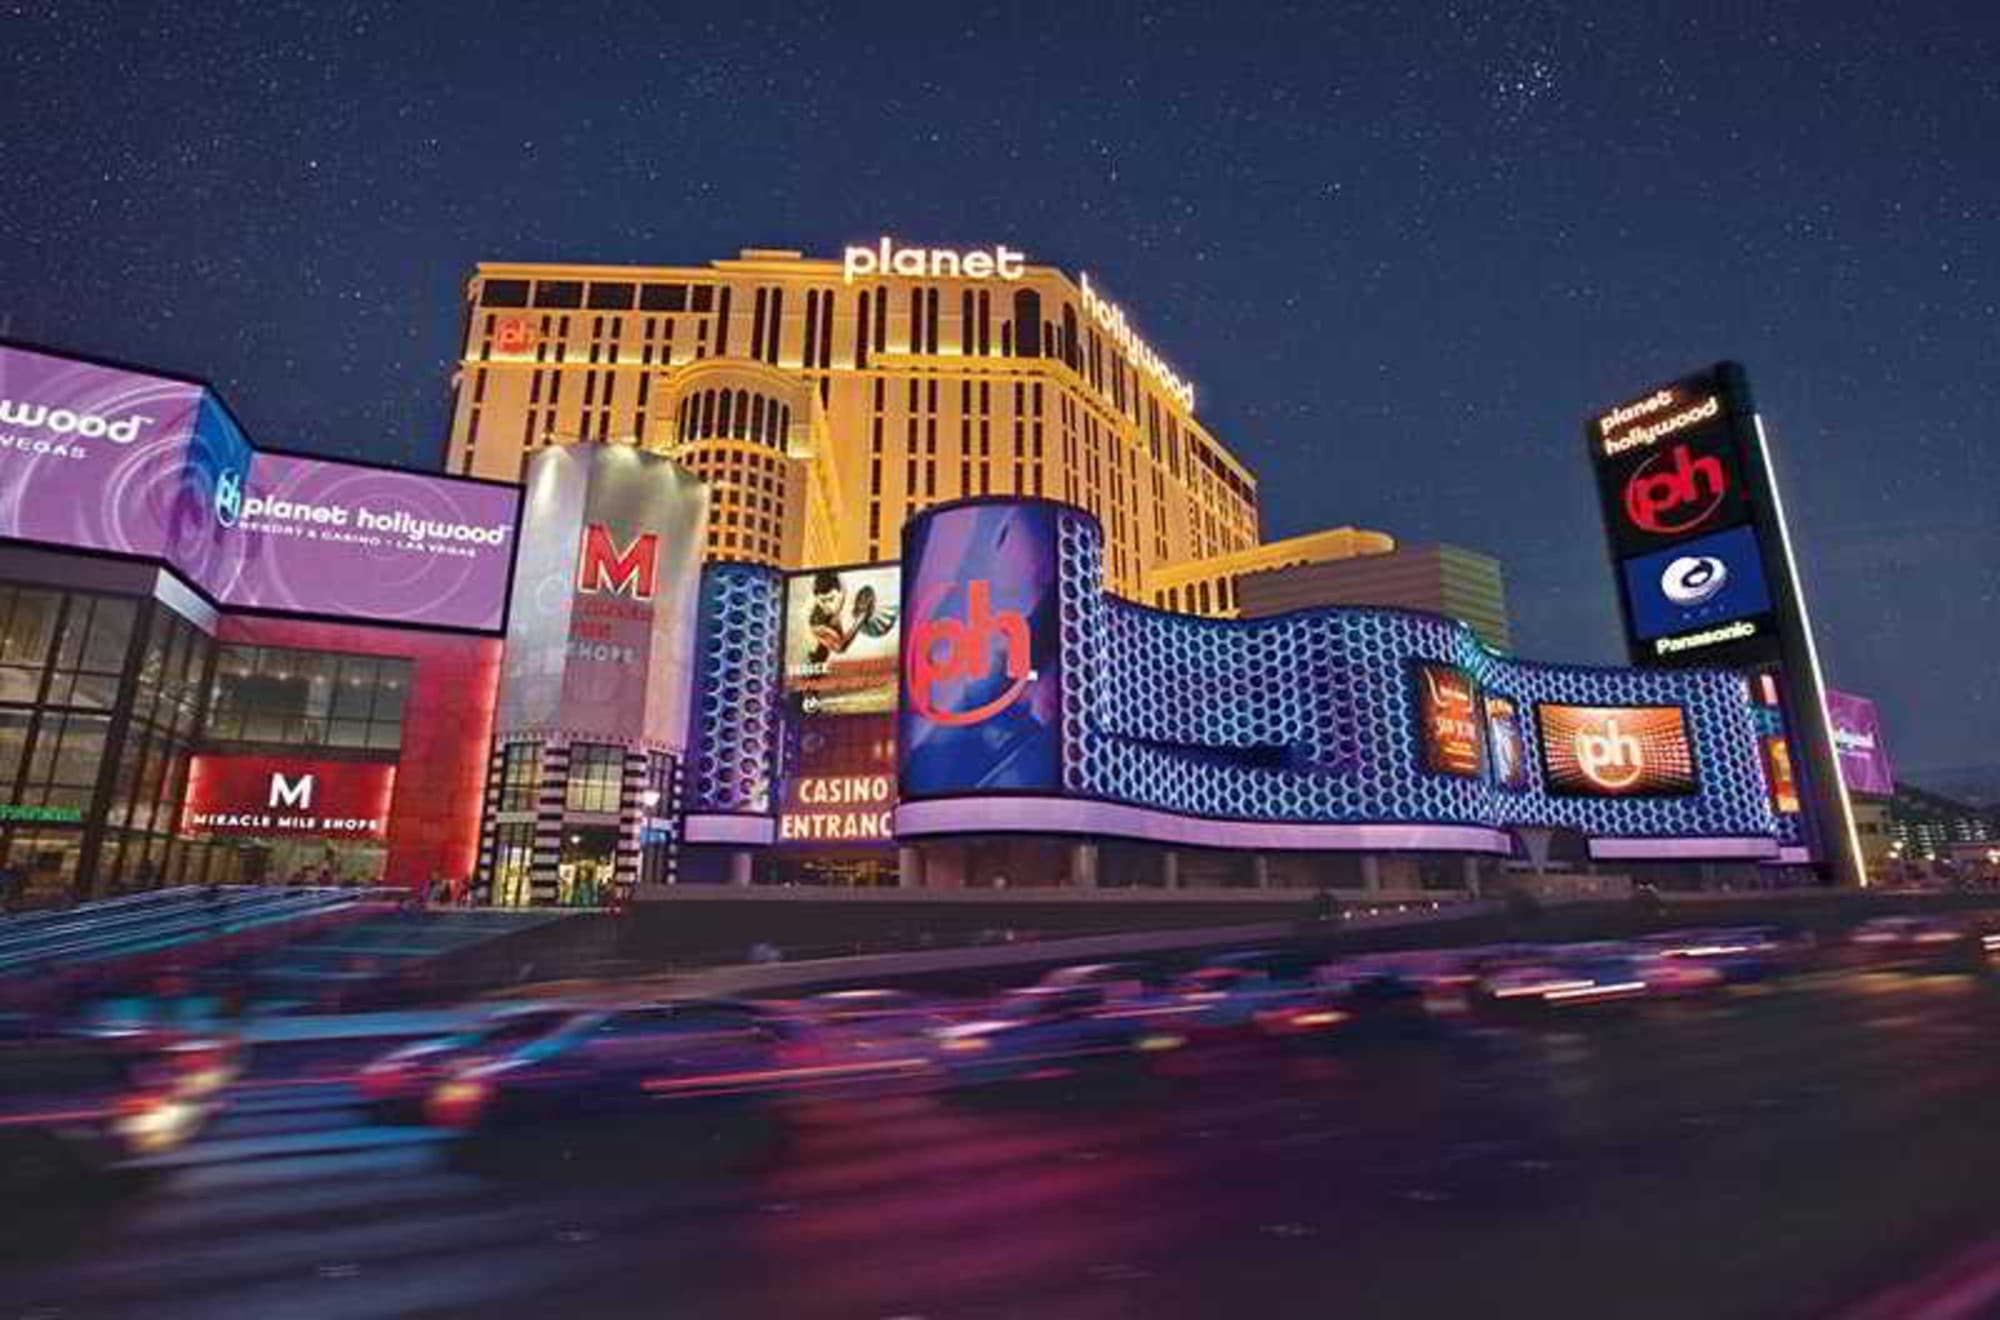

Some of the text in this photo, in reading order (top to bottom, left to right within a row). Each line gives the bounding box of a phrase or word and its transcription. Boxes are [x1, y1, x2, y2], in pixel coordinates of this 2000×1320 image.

[844, 237, 1025, 284] planet
[1081, 270, 1194, 416] hollywood
[1601, 390, 1673, 436] planet
[1605, 396, 1719, 456] hollywood
[0, 434, 85, 459] VEGAS
[1626, 445, 1725, 531] ph
[241, 494, 504, 546] planet hollywood
[577, 521, 660, 602] M
[907, 579, 1031, 727] ph
[1656, 620, 1756, 655] Panasonic
[1576, 718, 1642, 789] ph
[268, 771, 314, 810] M
[799, 776, 890, 803] CASINO
[192, 814, 272, 829] MIRACLE
[276, 816, 317, 830] MILE
[780, 811, 893, 840] ENTRANC
